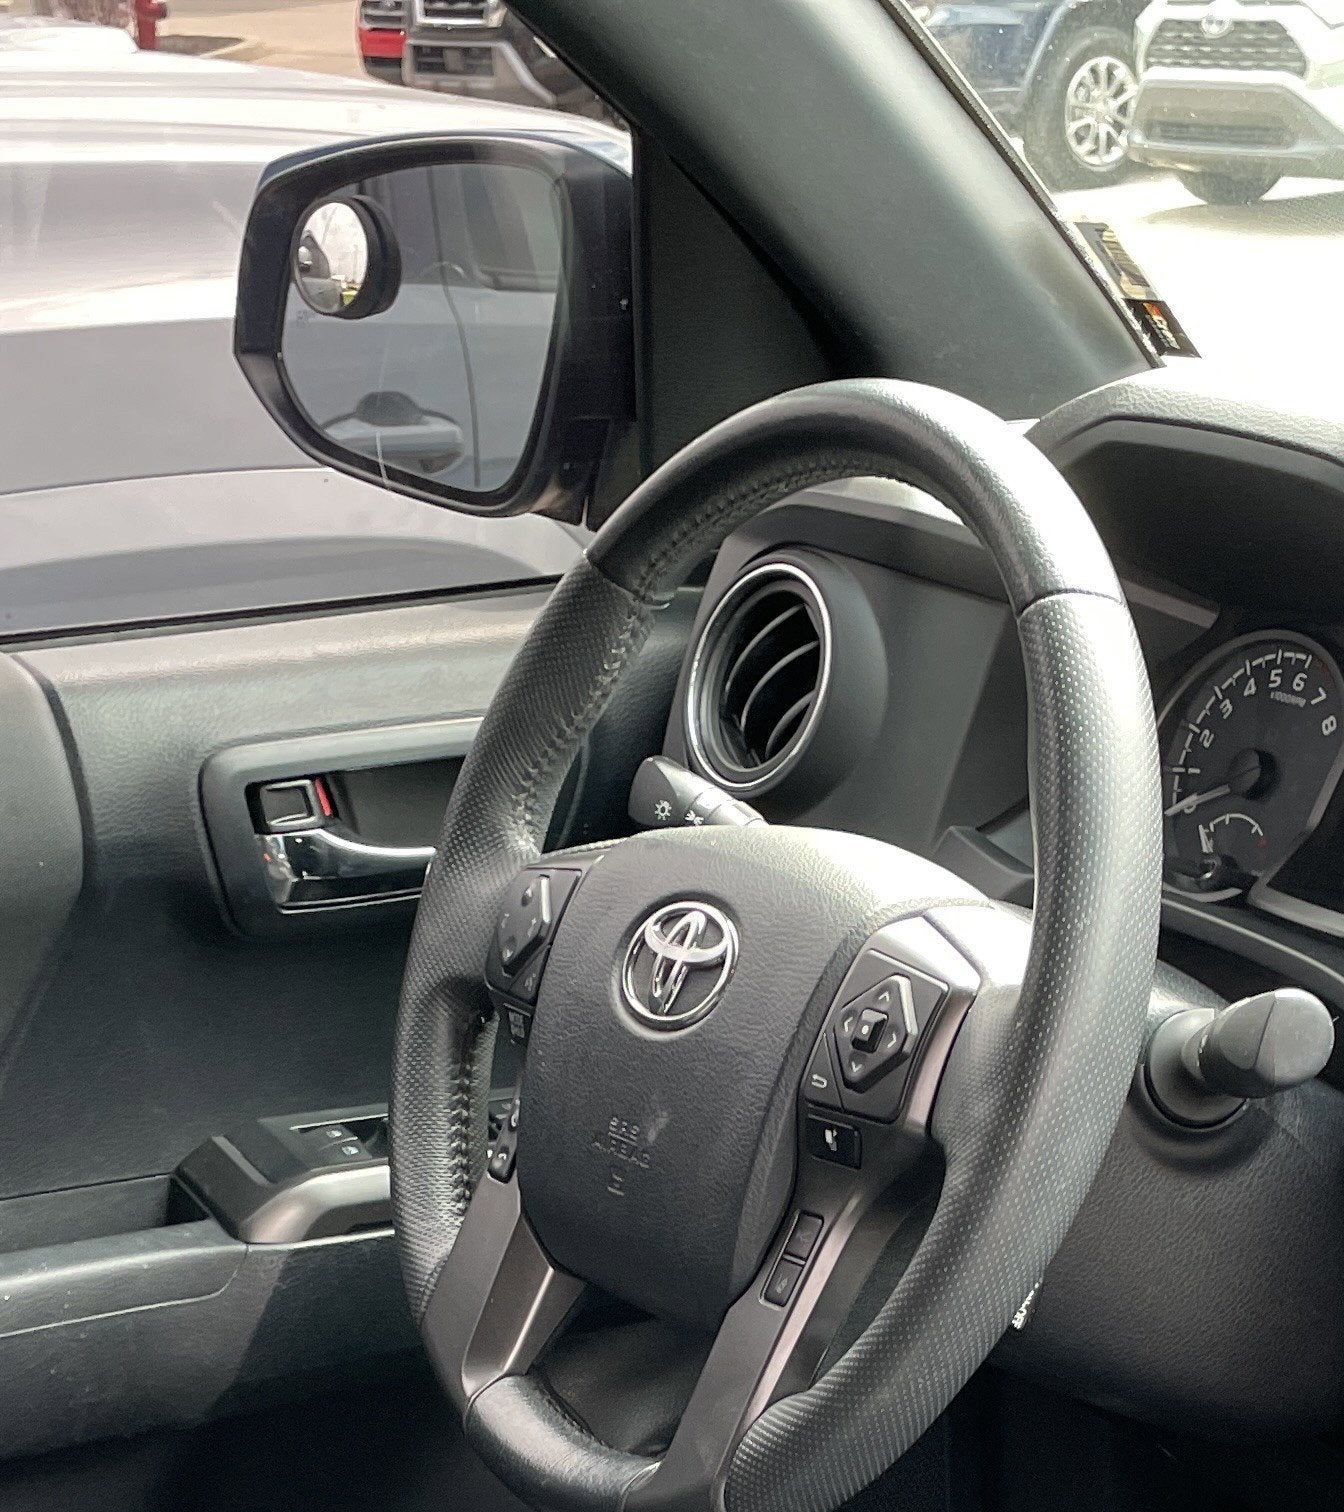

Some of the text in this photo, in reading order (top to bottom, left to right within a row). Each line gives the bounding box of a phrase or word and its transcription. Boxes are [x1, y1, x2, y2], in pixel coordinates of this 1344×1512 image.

[1244, 678, 1257, 697] 4
[1268, 670, 1282, 688] 5
[1292, 673, 1307, 692] 6
[1311, 687, 1327, 706] 7
[1220, 701, 1233, 719] 3
[1321, 715, 1337, 736] 8
[1200, 731, 1214, 748] 2
